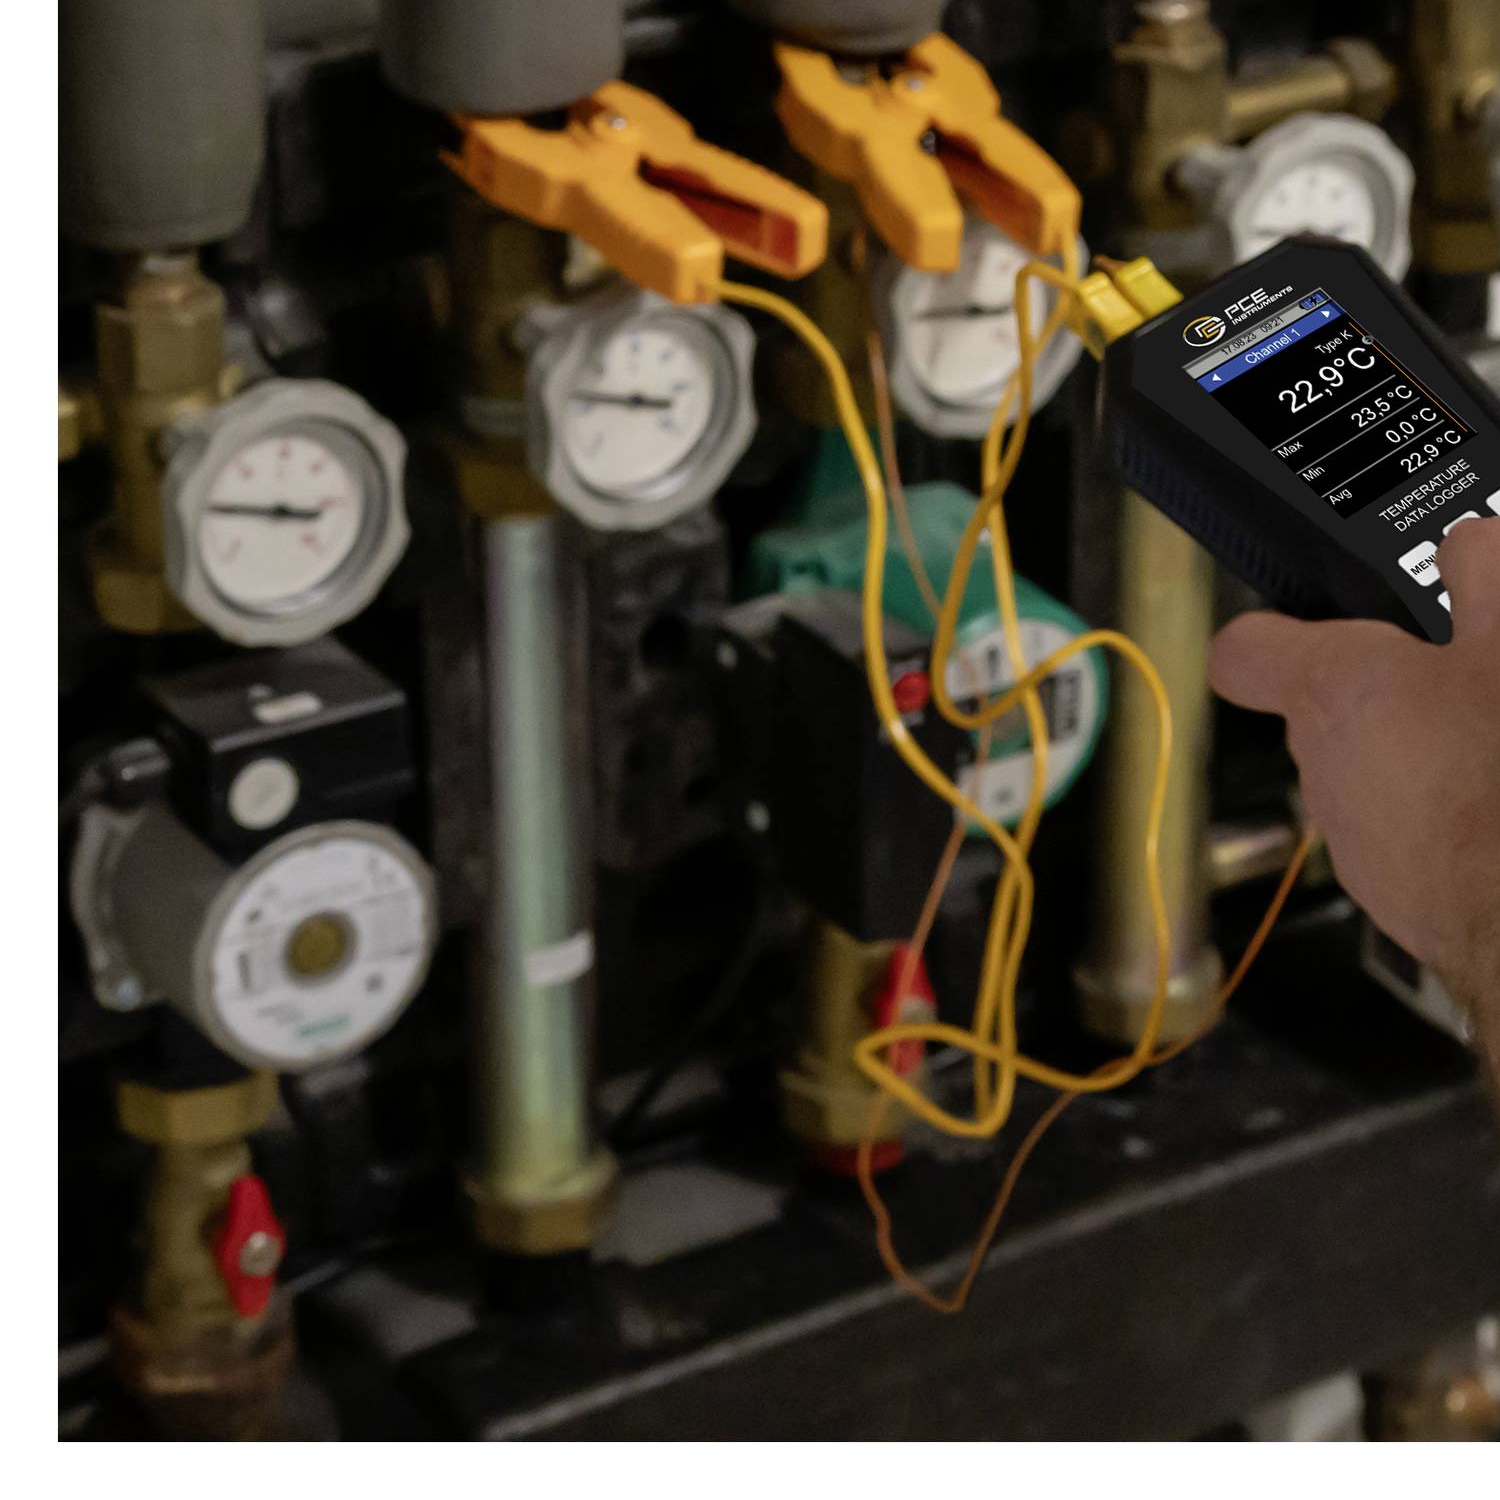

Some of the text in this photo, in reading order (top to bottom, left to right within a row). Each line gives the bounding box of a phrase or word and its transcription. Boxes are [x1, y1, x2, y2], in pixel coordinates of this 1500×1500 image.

[1224, 287, 1269, 320] PCE
[1231, 285, 1294, 326] INSTRUMENTS
[1245, 328, 1301, 364] Channel 1
[1315, 329, 1353, 355] Type K
[1277, 441, 1304, 458] Max
[1302, 465, 1326, 482] Min
[1378, 458, 1471, 522] TEMPERATURE
[1328, 488, 1353, 505] Avg
[1394, 472, 1480, 532] DATA LOGGER
